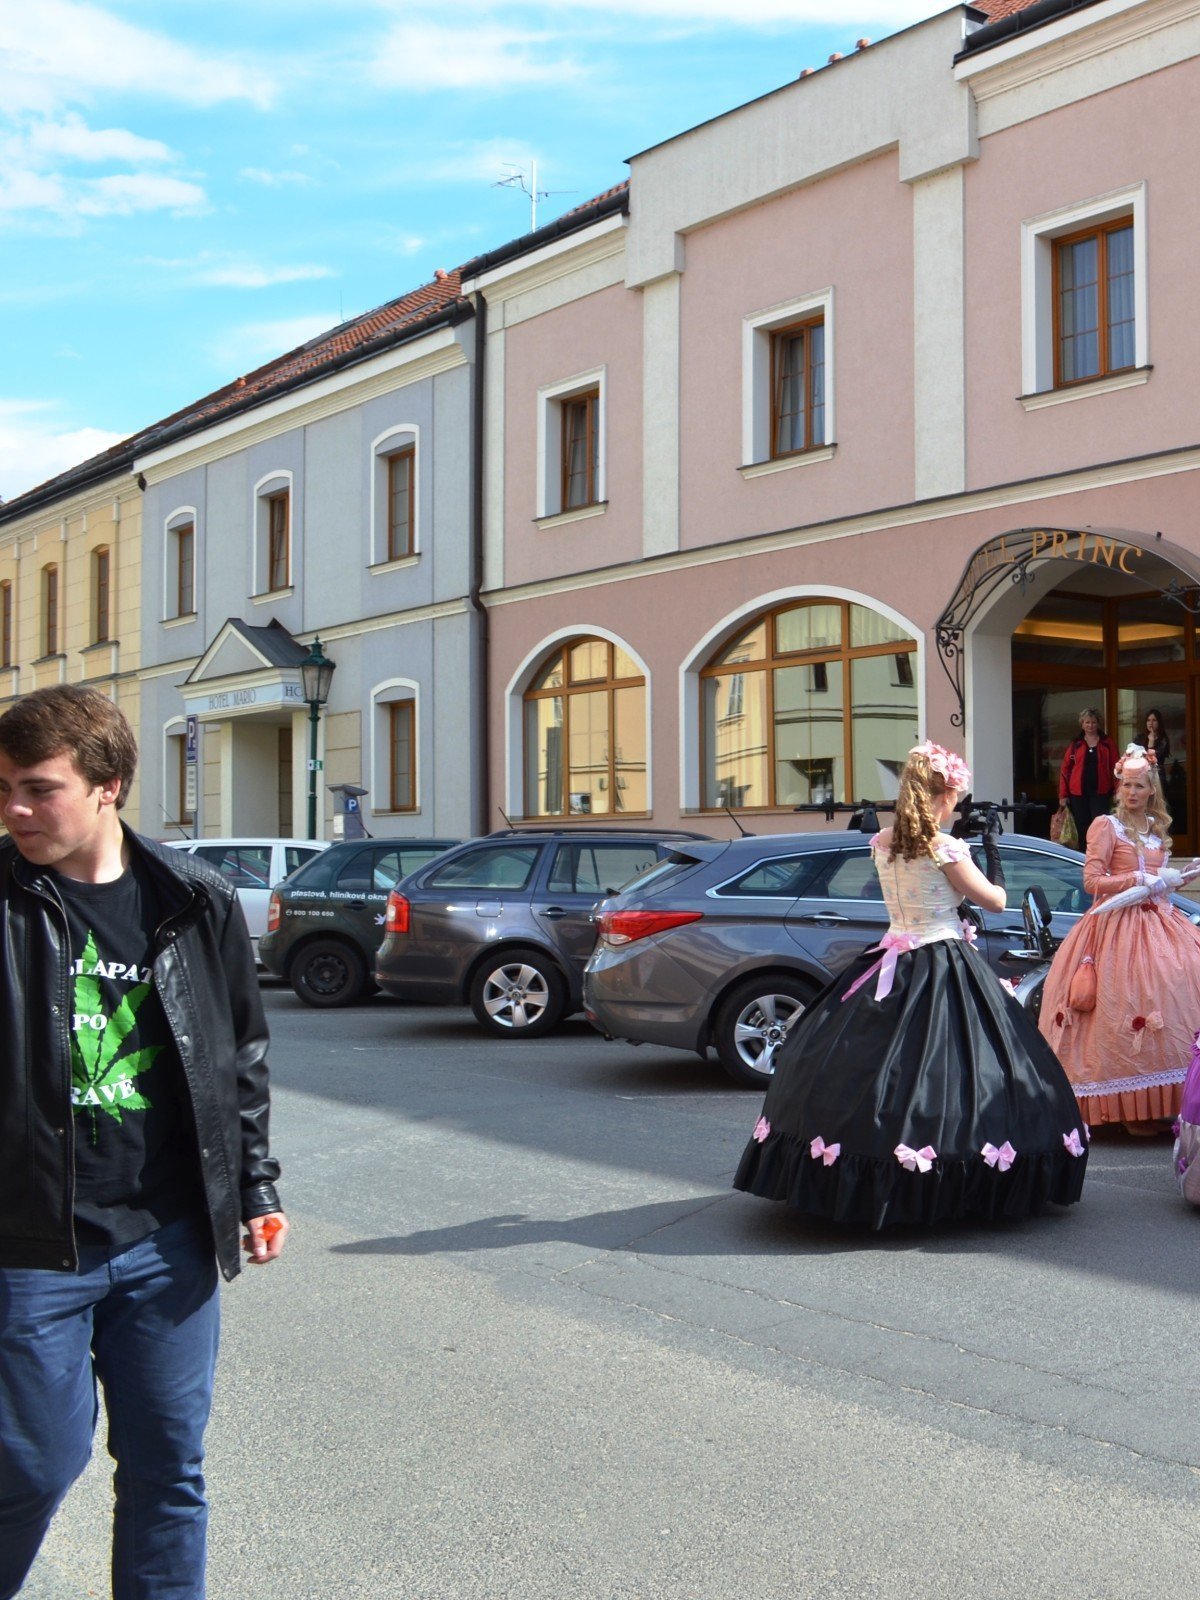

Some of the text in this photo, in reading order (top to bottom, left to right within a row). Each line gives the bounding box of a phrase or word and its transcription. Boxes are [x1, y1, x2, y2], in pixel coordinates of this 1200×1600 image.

[1031, 530, 1142, 575] PRINC
[208, 687, 257, 710] HOTEL MARIO
[285, 685, 303, 697] HO
[348, 798, 357, 812] P
[291, 890, 388, 901] plastová, hliníková okna
[72, 1013, 108, 1031] PO
[70, 1072, 136, 1106] RAVĚ
